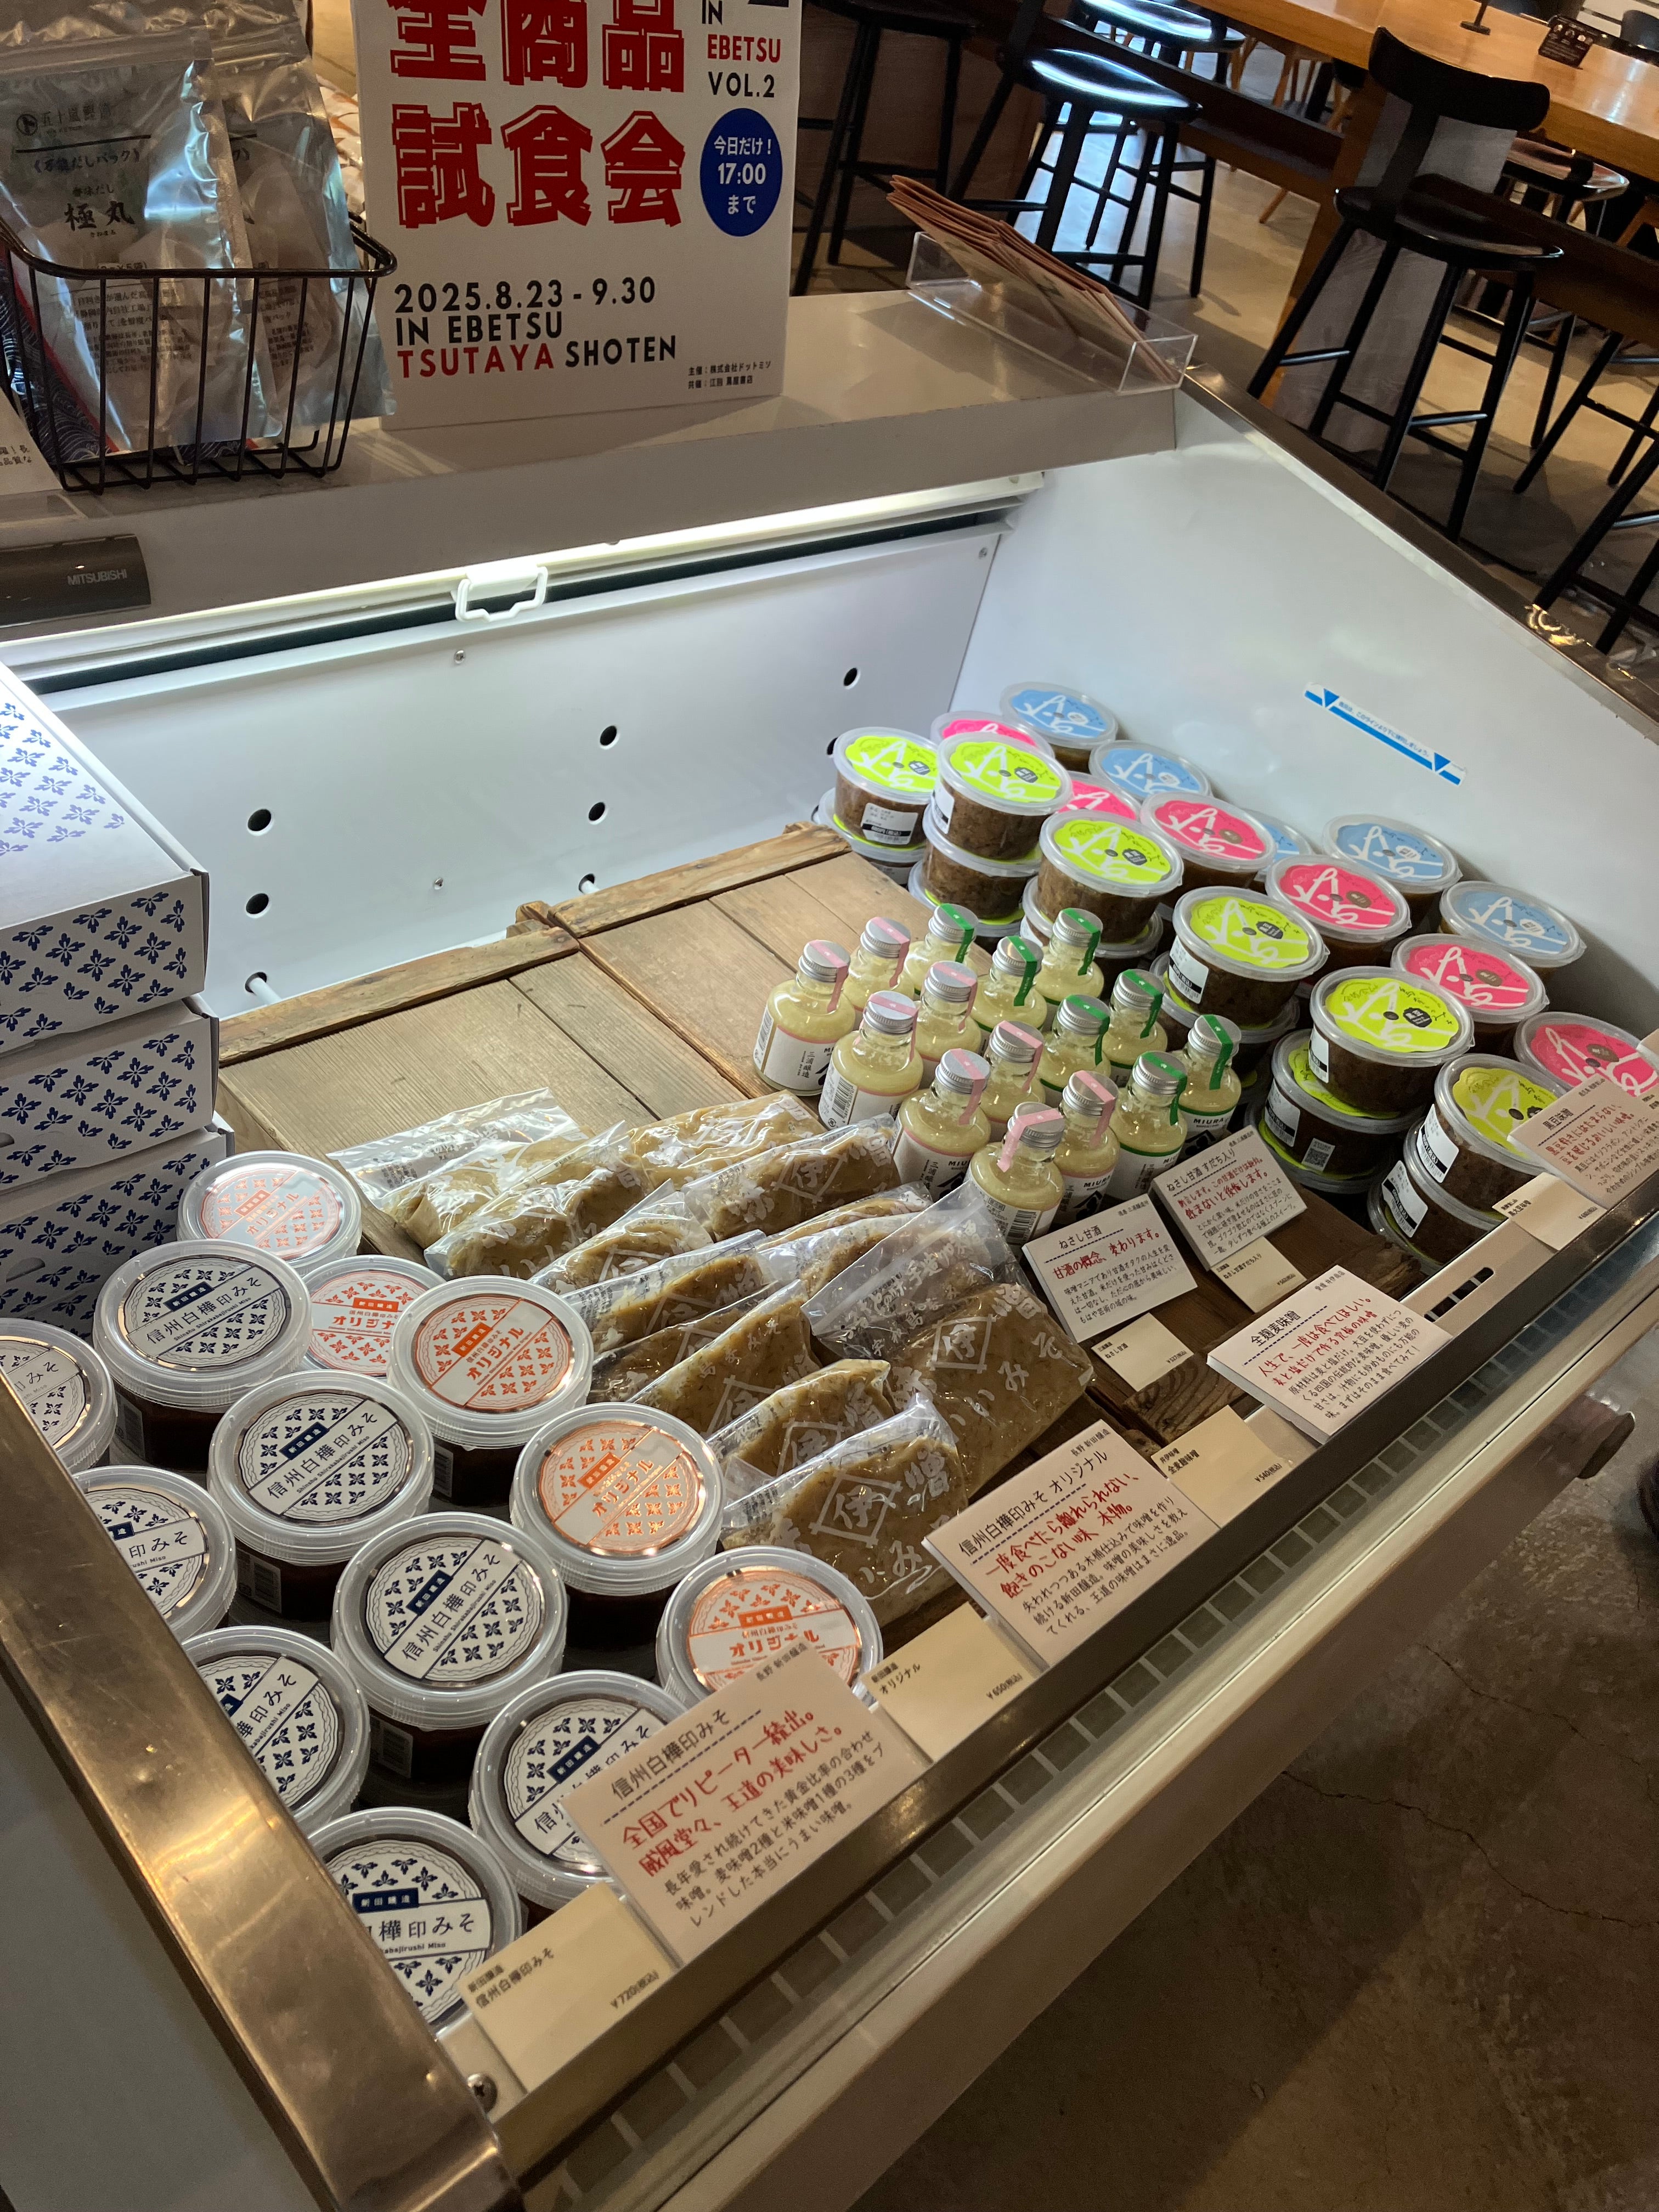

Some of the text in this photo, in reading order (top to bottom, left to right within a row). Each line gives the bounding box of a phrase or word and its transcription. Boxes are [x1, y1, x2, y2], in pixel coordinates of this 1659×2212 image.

[389, 0, 686, 93] 全商品
[706, 34, 782, 64] EBETSU
[707, 71, 775, 98] VOL.2
[391, 102, 686, 228] 試食会
[713, 136, 772, 156] 今日だけ！
[718, 162, 766, 187] 17:00
[726, 194, 757, 215] まで
[394, 280, 563, 313] 2025.8.23
[591, 276, 656, 306] 9.30
[396, 311, 563, 346] IN EBETSU
[397, 335, 676, 379] TSUTAYA SHOTEN
[67, 569, 127, 586] MITSUBISHI
[1542, 1108, 1574, 1131] 黒豆味噌
[1545, 1104, 1622, 1156] 黒豆好きにはたまらない、
[1559, 1111, 1634, 1165] 豆を感じるおいしい味噌。
[1166, 1148, 1235, 1192] ねさし甘酒 すだち入り
[1184, 1168, 1267, 1220] 飲まないと後悔します。
[246, 1193, 299, 1235] オリジナル
[1059, 1224, 1102, 1249] ねさし甘酒
[1063, 1244, 1170, 1295] 味噌マニアであり甘酒オタクの人生を変
[1070, 1253, 1174, 1305] えた甘酒。米だけを使った甘みはくどさ
[140, 1277, 268, 1344] 信州白樺印みそ
[1079, 1294, 1137, 1324] もはや芸術の域の味。
[1251, 1310, 1301, 1347] 全麹麦味噌
[466, 1328, 524, 1380] オリジナル
[1104, 1342, 1128, 1358] ねさし甘酒
[1258, 1298, 1371, 1377] 人生で、一度は食べてほしい。
[1272, 1310, 1378, 1386] 麦と塩だけで作る究極の味噌
[1288, 1310, 1401, 1395] 原材料は麦と塩だけ。大豆を使わずにつ
[1302, 1317, 1413, 1401] くる四国の伝統的な麦味噌。優しい麦の
[1313, 1328, 1420, 1410] 甘さは、汁物にも炒めものにも万能の
[1324, 1345, 1420, 1418] 味。まずはそのまま食べてみて！
[267, 1412, 377, 1499] 信州白樺印みそ
[1069, 1428, 1111, 1457] 長野 新田醸造
[591, 1460, 654, 1516] オリジナル
[958, 1451, 1107, 1557] 信州白樺印みそ オリジナル
[986, 1473, 1139, 1575] 一度食べたら離れられない、
[1022, 1496, 1174, 1613] 失われつつある木桶仕込みで味噌を作り
[1033, 1508, 1188, 1625] 続ける新田醸造。味噌の美味しさを教え
[1046, 1530, 1188, 1634] てくれる、王道の味噌はまさに逸品。
[401, 1553, 500, 1661] 信州白樺印みそ
[879, 1663, 921, 1694] オリジナル
[611, 1709, 730, 1800] 信州白樺印みそ
[623, 1710, 814, 1849] 全国でリピーター続出。
[638, 1726, 842, 1877] 威風堂々、王道の美味しさ。
[664, 1731, 873, 1896] 長年愛され続けてきた黄金比率の合わせ
[675, 1742, 883, 1910] 味噌。麦味噌2種と米味噌1種の3種をブ
[690, 1800, 852, 1927] レンドした本当にうまい味噌。
[476, 1948, 554, 2008] 信州白樺印みそ
